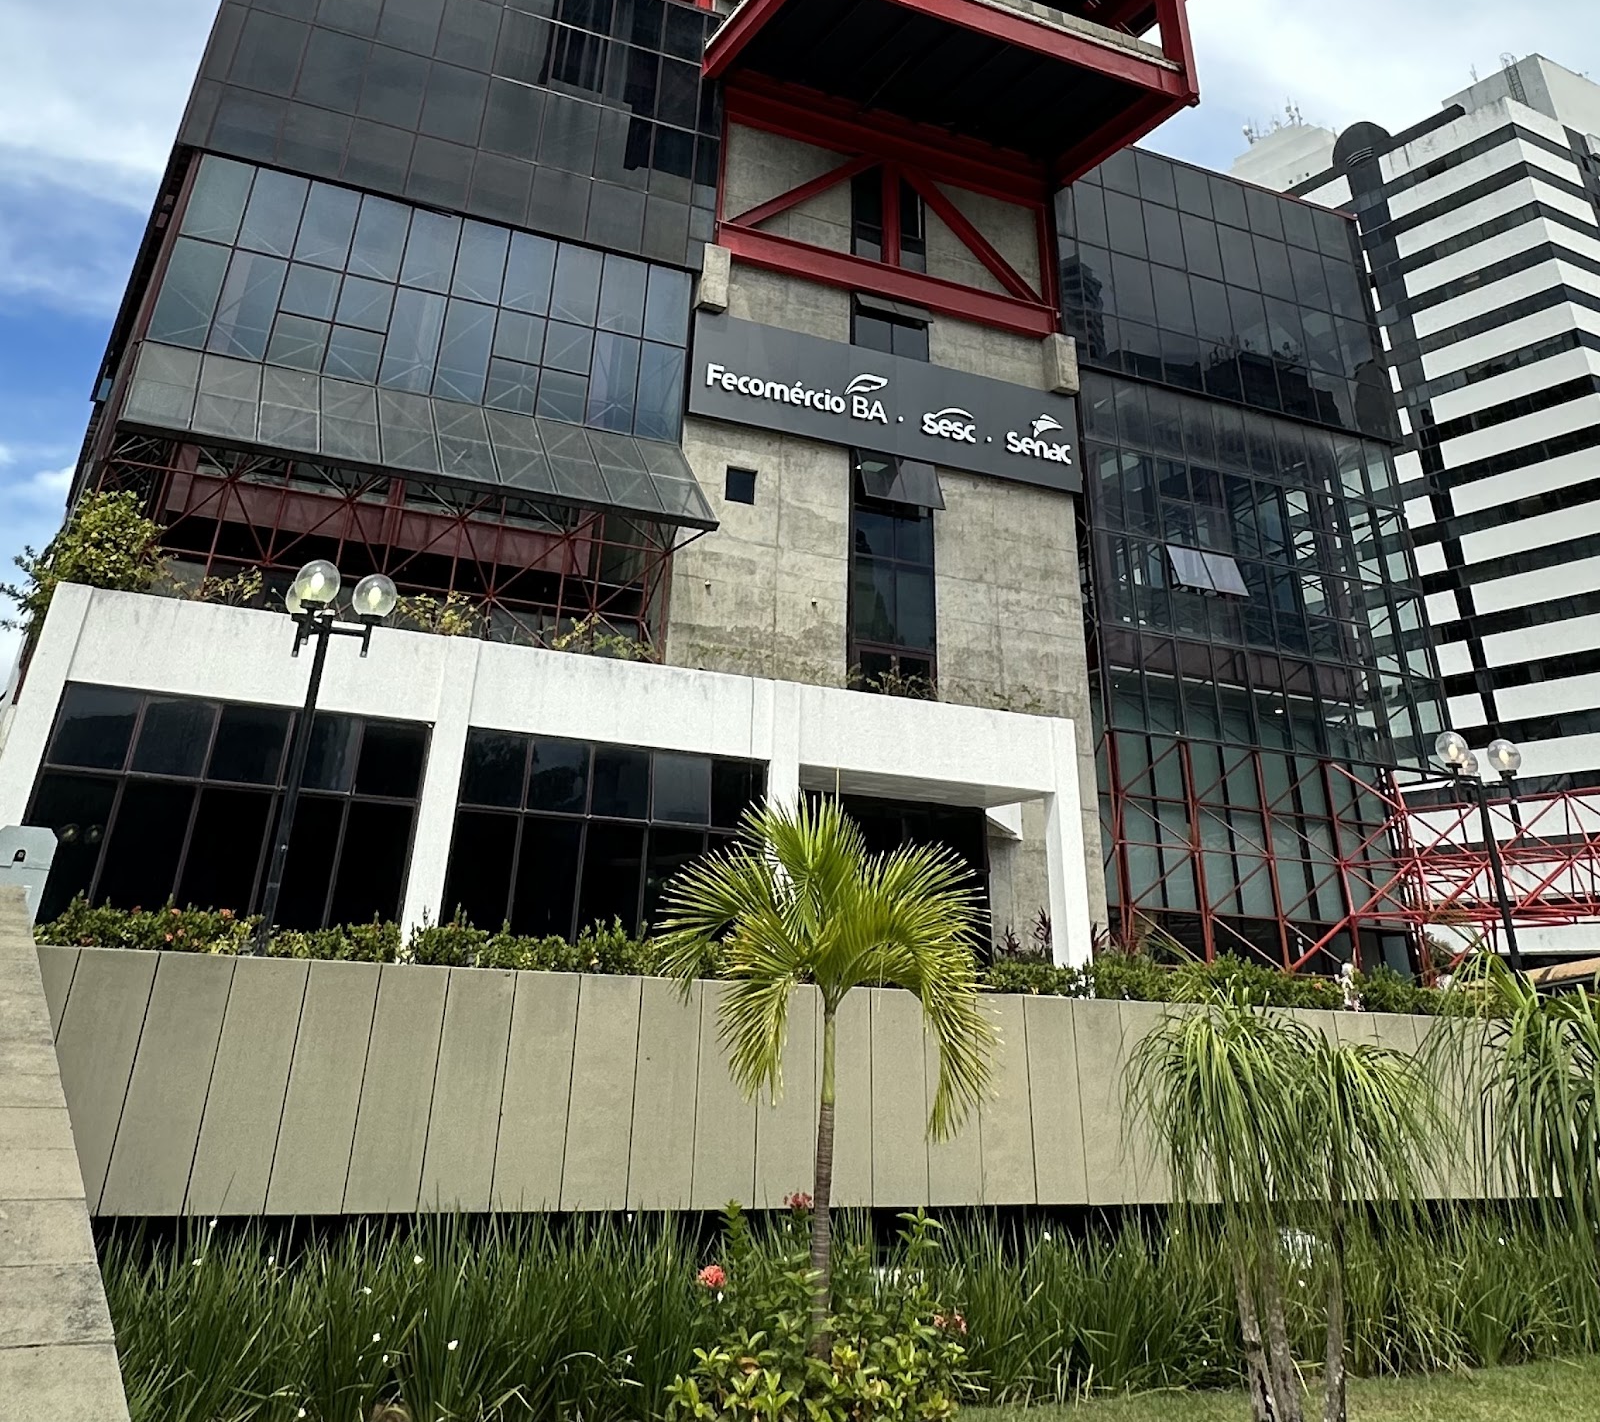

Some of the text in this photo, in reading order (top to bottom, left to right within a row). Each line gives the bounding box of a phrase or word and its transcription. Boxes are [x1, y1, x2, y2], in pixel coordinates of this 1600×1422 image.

[706, 363, 1072, 465] Fecomércio BA Sesc Senac
